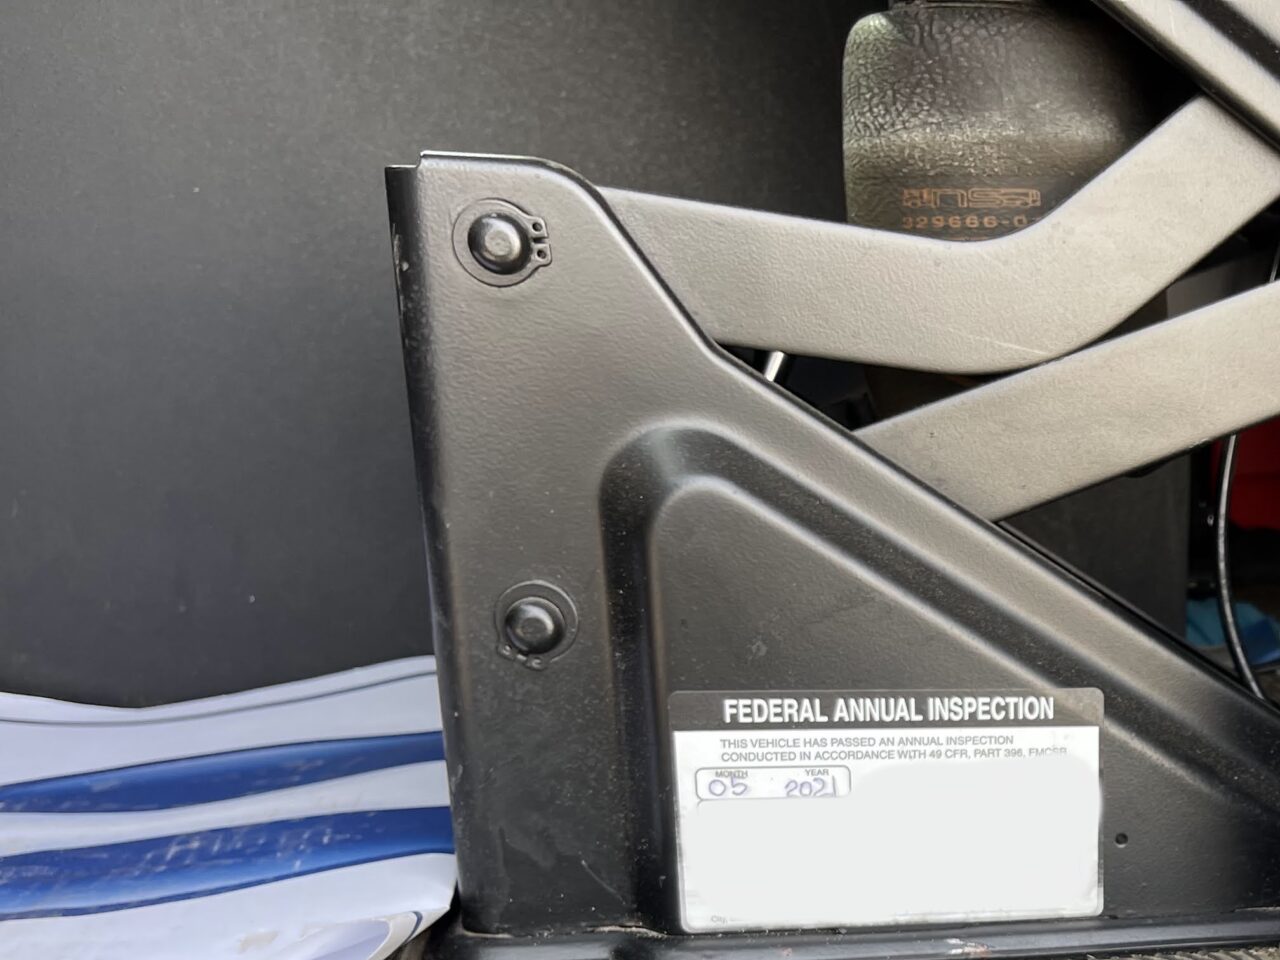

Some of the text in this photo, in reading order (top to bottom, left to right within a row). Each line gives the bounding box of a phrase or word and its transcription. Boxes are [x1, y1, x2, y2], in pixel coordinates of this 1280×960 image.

[724, 696, 1054, 723] FEDERAL ANNUAL INSPECTION
[720, 735, 1014, 749] THIS VEHICLE HAS PASSED AN ANNUAL INSPECTION
[721, 751, 797, 762] CONDUCTED
[799, 751, 812, 761] IN
[814, 750, 894, 761] ACCORDANCE
[898, 749, 927, 760] WITH
[928, 749, 942, 759] 49
[944, 748, 971, 760] CFR,
[973, 748, 1002, 758] PART
[715, 768, 829, 779] MONTH YEAR
[784, 775, 838, 797] 2021
